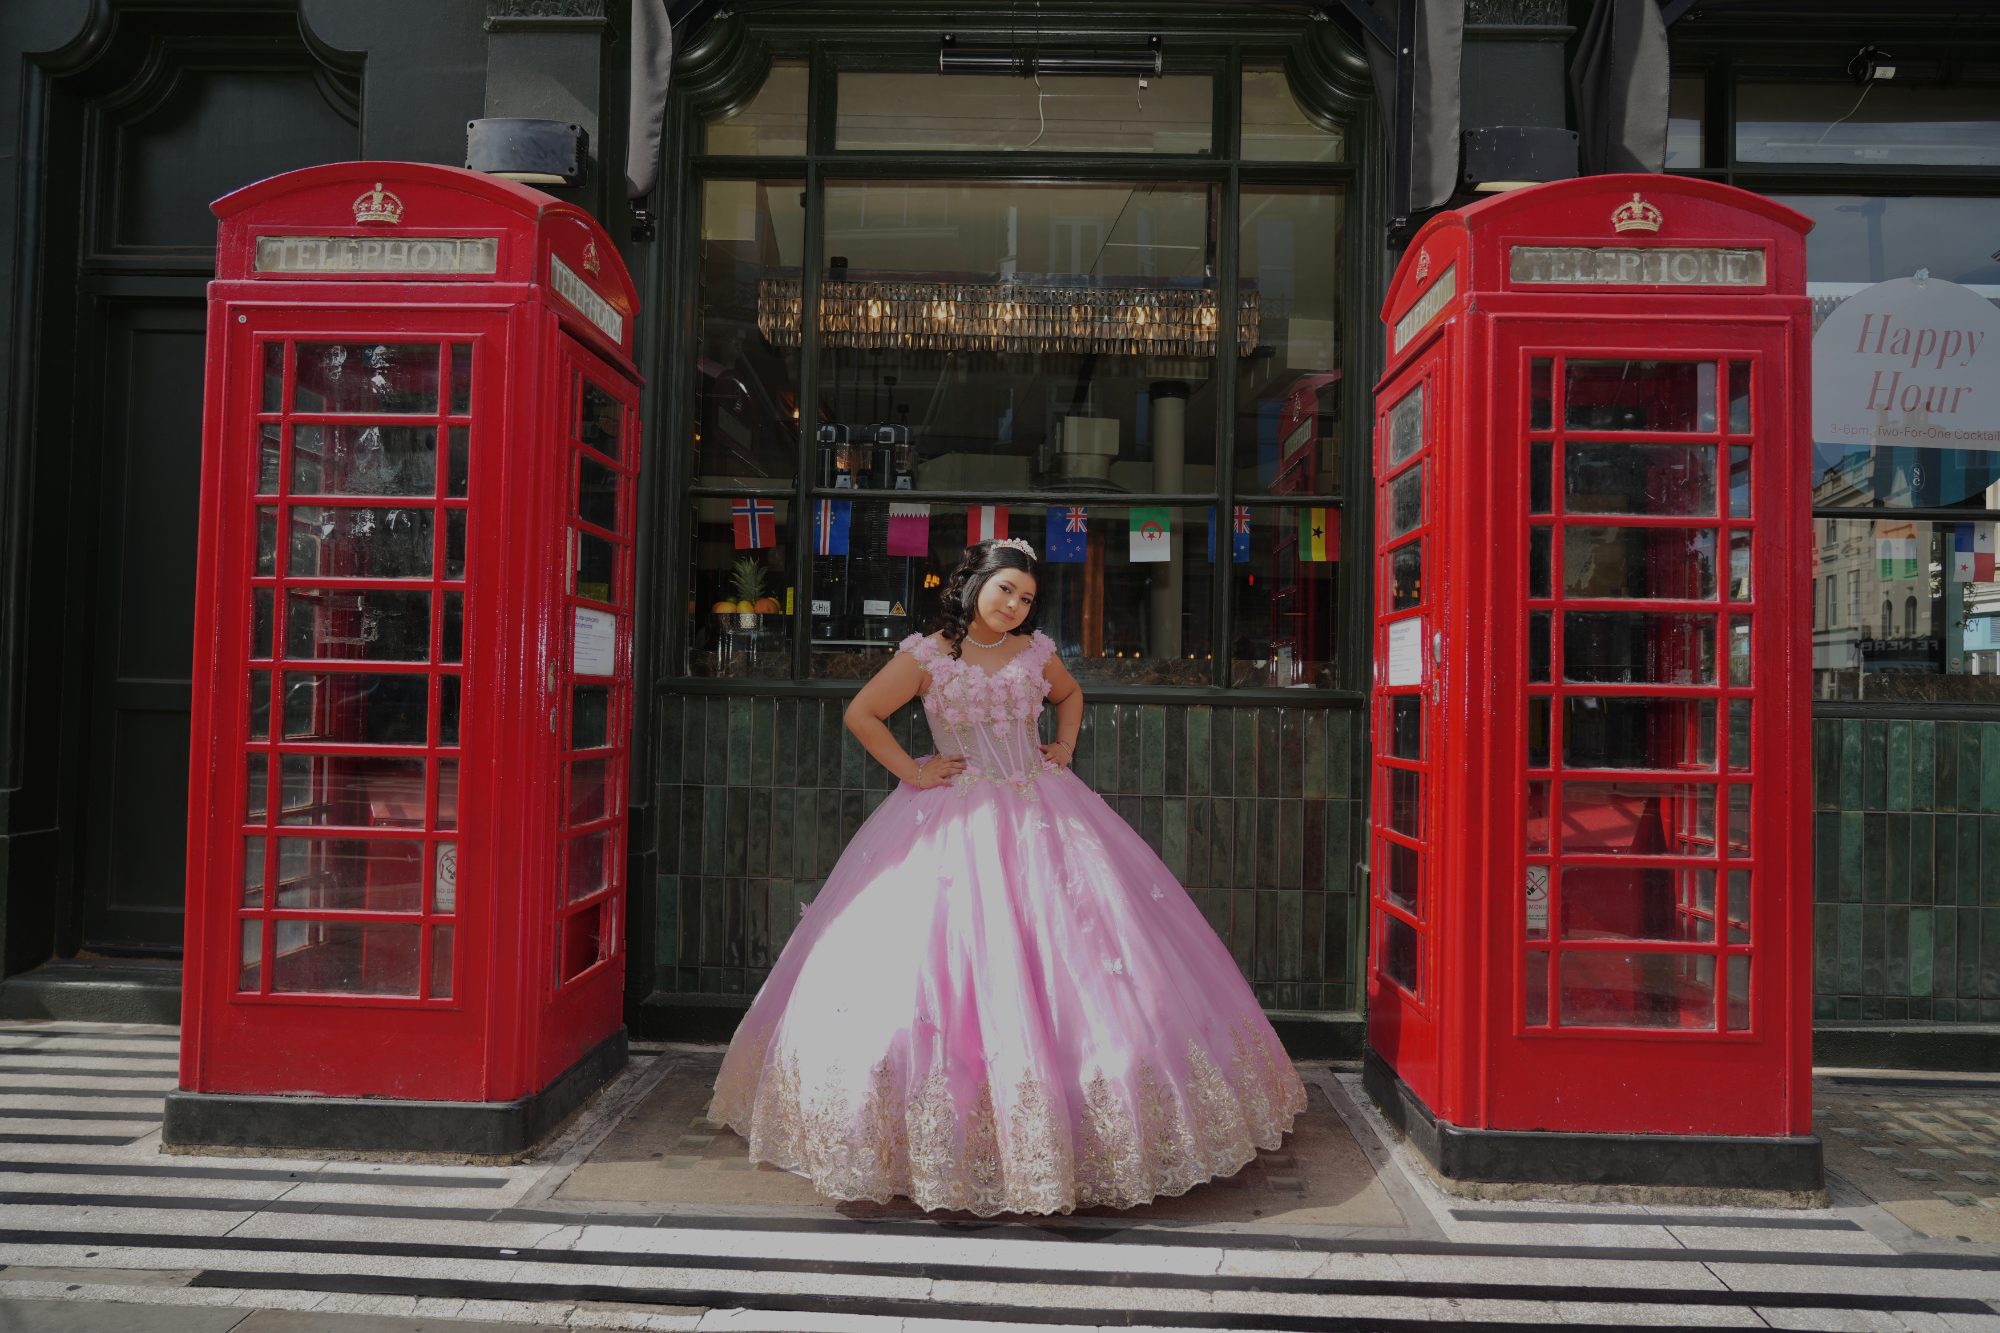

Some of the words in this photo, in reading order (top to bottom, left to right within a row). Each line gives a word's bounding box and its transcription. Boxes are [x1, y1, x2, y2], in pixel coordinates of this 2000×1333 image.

[266, 238, 484, 271] TELEPHONE
[1523, 251, 1749, 283] TELEPHONE
[553, 257, 622, 344] TELEPHONE
[1856, 313, 1984, 369] Happy
[1865, 370, 1973, 414] Hour
[1878, 425, 1951, 439] Two-For-One
